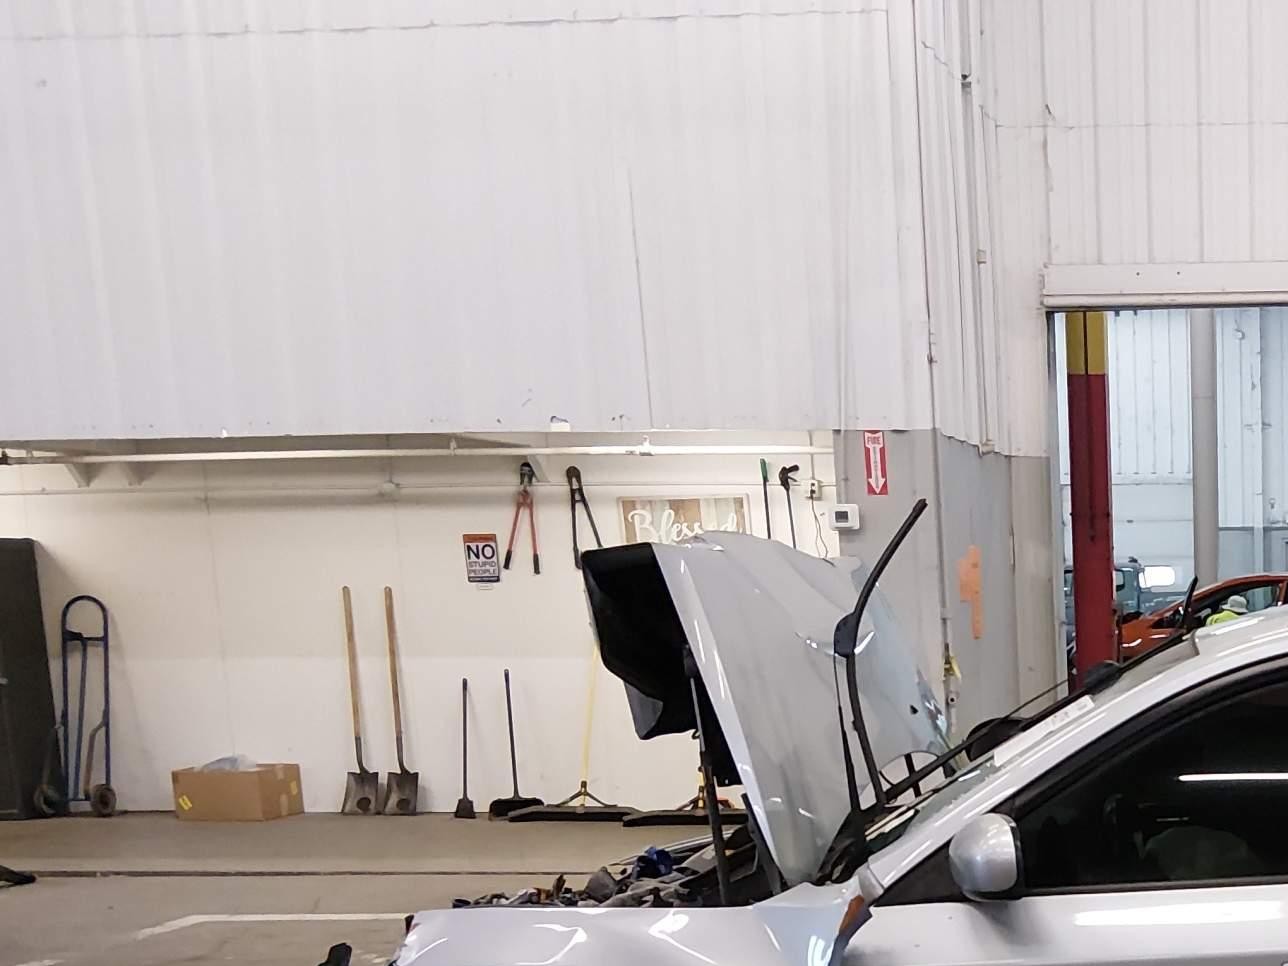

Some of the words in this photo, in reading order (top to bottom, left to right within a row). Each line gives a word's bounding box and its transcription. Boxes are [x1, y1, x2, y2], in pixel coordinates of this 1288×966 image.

[628, 509, 737, 544] Blessd
[466, 543, 495, 560] NO
[468, 560, 497, 568] STUPID
